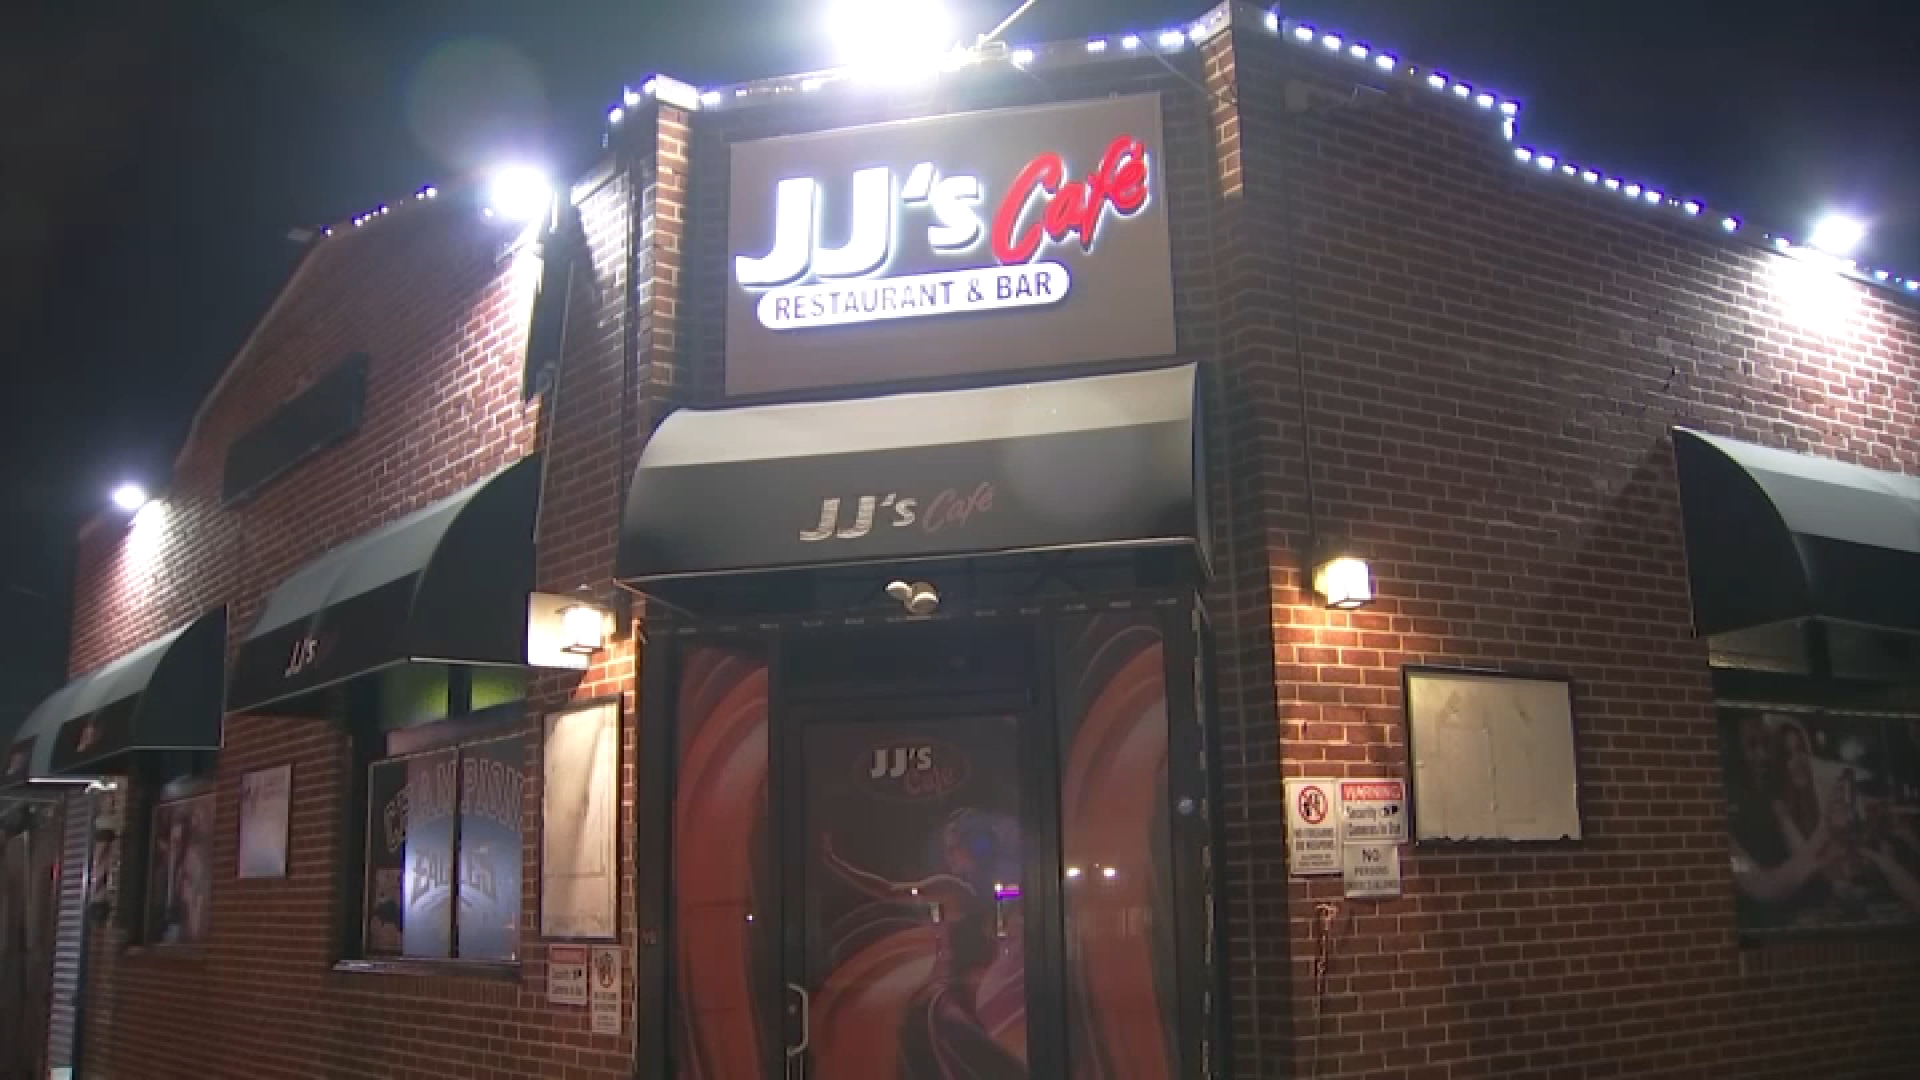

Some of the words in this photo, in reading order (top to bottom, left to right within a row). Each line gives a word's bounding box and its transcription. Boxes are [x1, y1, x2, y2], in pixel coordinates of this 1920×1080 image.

[991, 134, 1149, 265] Café
[774, 280, 955, 322] RESTAURANT
[966, 276, 985, 303] &
[996, 271, 1052, 301] BAR
[1344, 784, 1401, 800] WARNING
[1346, 805, 1377, 822] Security
[1362, 848, 1381, 863] NO
